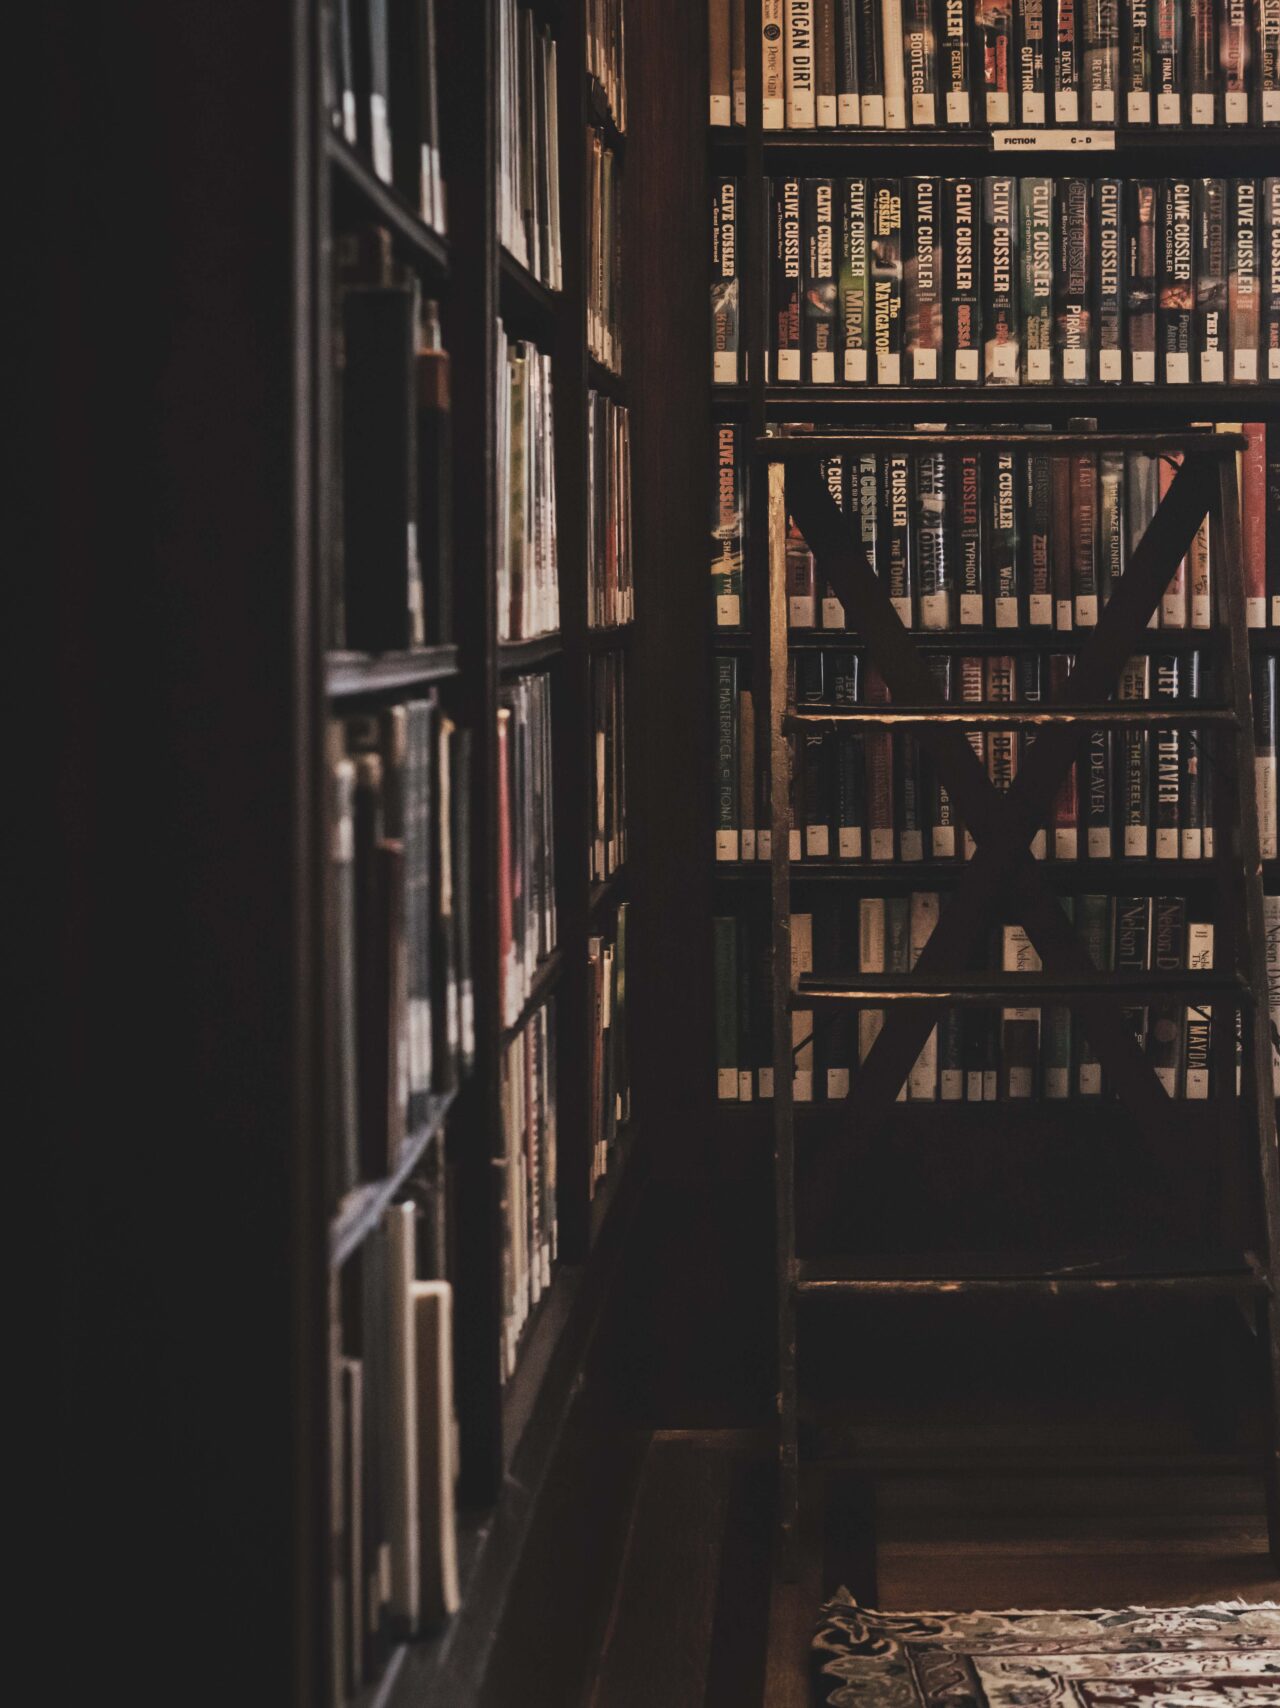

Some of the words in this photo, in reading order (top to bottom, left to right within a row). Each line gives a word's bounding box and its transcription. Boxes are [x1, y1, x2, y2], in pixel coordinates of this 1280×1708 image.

[767, 46, 779, 70] Pope
[793, 56, 810, 92] DIRT
[910, 33, 923, 95] BOOTLEGG
[951, 50, 961, 80] CELTIC
[1034, 53, 1043, 70] THE
[1062, 51, 1072, 84] DEVIL'S
[1133, 45, 1143, 64] EYE
[1163, 58, 1173, 81] FINAL
[1263, 52, 1273, 78] GRAY
[952, 81, 961, 93] EM
[1092, 60, 1102, 91] REVEN
[1004, 137, 1036, 145] FICTION
[722, 184, 736, 220] CLIVE
[785, 183, 799, 219] CLIVE
[817, 186, 832, 223] CLIVE
[851, 183, 864, 219] CLIVE
[878, 189, 890, 236] CUSSLER
[890, 196, 901, 230] CLIVE
[917, 183, 933, 223] CLIVE
[956, 184, 973, 225] CLIVE
[993, 182, 1010, 224] CLIVE
[1034, 186, 1049, 228] CLIVE
[1070, 182, 1086, 225] CLIVE
[1101, 185, 1118, 225] CLIVE
[1174, 184, 1191, 220] CLIVE
[1209, 184, 1222, 220] CLIVE
[1237, 185, 1254, 226] CLIVE
[722, 224, 736, 277] CUSSLER
[785, 222, 799, 278] CUSSLER
[817, 225, 832, 279] CUSSLER
[851, 221, 864, 277] CUSSLER
[917, 226, 933, 289] CUSSLER
[956, 227, 973, 291] CUSSLER
[993, 227, 1010, 293] CUSSLER
[1034, 232, 1049, 297] CUSSLER
[1070, 229, 1086, 295] CUSSLER
[1101, 230, 1118, 295] CUSSLER
[1174, 224, 1191, 280] CUSSLER
[1209, 224, 1222, 277] CUSSLER
[1237, 229, 1254, 295] CUSSLER
[844, 290, 864, 350] MIRAG
[875, 282, 890, 356] NAVIGATOR
[889, 297, 901, 319] The
[957, 304, 972, 349] ODESSA
[1067, 305, 1082, 350] PIRANH
[1206, 312, 1219, 335] THE
[716, 313, 727, 352] KINGD
[1167, 324, 1179, 353] ARRO
[1270, 323, 1279, 349] RANS
[718, 429, 734, 466] CLIVE
[718, 468, 734, 523] CUSSLER
[860, 476, 877, 543] CUSSLER
[892, 469, 907, 527] CUSSLER
[962, 468, 977, 524] CUSSLER
[999, 473, 1013, 530] CUSSLER
[1111, 506, 1119, 533] MAZE
[891, 540, 901, 557] THE
[964, 541, 976, 587] TYPHOON
[1032, 535, 1047, 566] ZERO
[1111, 536, 1120, 577] RUNNER
[723, 579, 732, 595] TYR
[891, 559, 906, 598] TOMB
[1000, 566, 1013, 598] WREC
[1033, 568, 1047, 595] HOU
[720, 664, 731, 684] THE
[835, 677, 845, 703] DEA
[845, 676, 855, 702] JEFF
[1124, 675, 1133, 699] DEA
[1158, 666, 1179, 695] JEF
[720, 688, 731, 761] MASTERPIECE
[993, 737, 1011, 790] DEAVE
[1131, 743, 1141, 767] THE
[1158, 742, 1179, 803] DEAVER
[1091, 752, 1105, 815] DEAVER
[1131, 770, 1141, 807] STEEL
[721, 786, 732, 821] FIONA
[940, 805, 949, 826] EDG
[1118, 905, 1143, 957] Nelson
[1156, 904, 1180, 953] Nelson
[1017, 945, 1032, 971] Nelso
[1200, 949, 1210, 970] Nels
[1265, 968, 1280, 1014] DeMille
[1188, 1026, 1207, 1069] MAYDA
